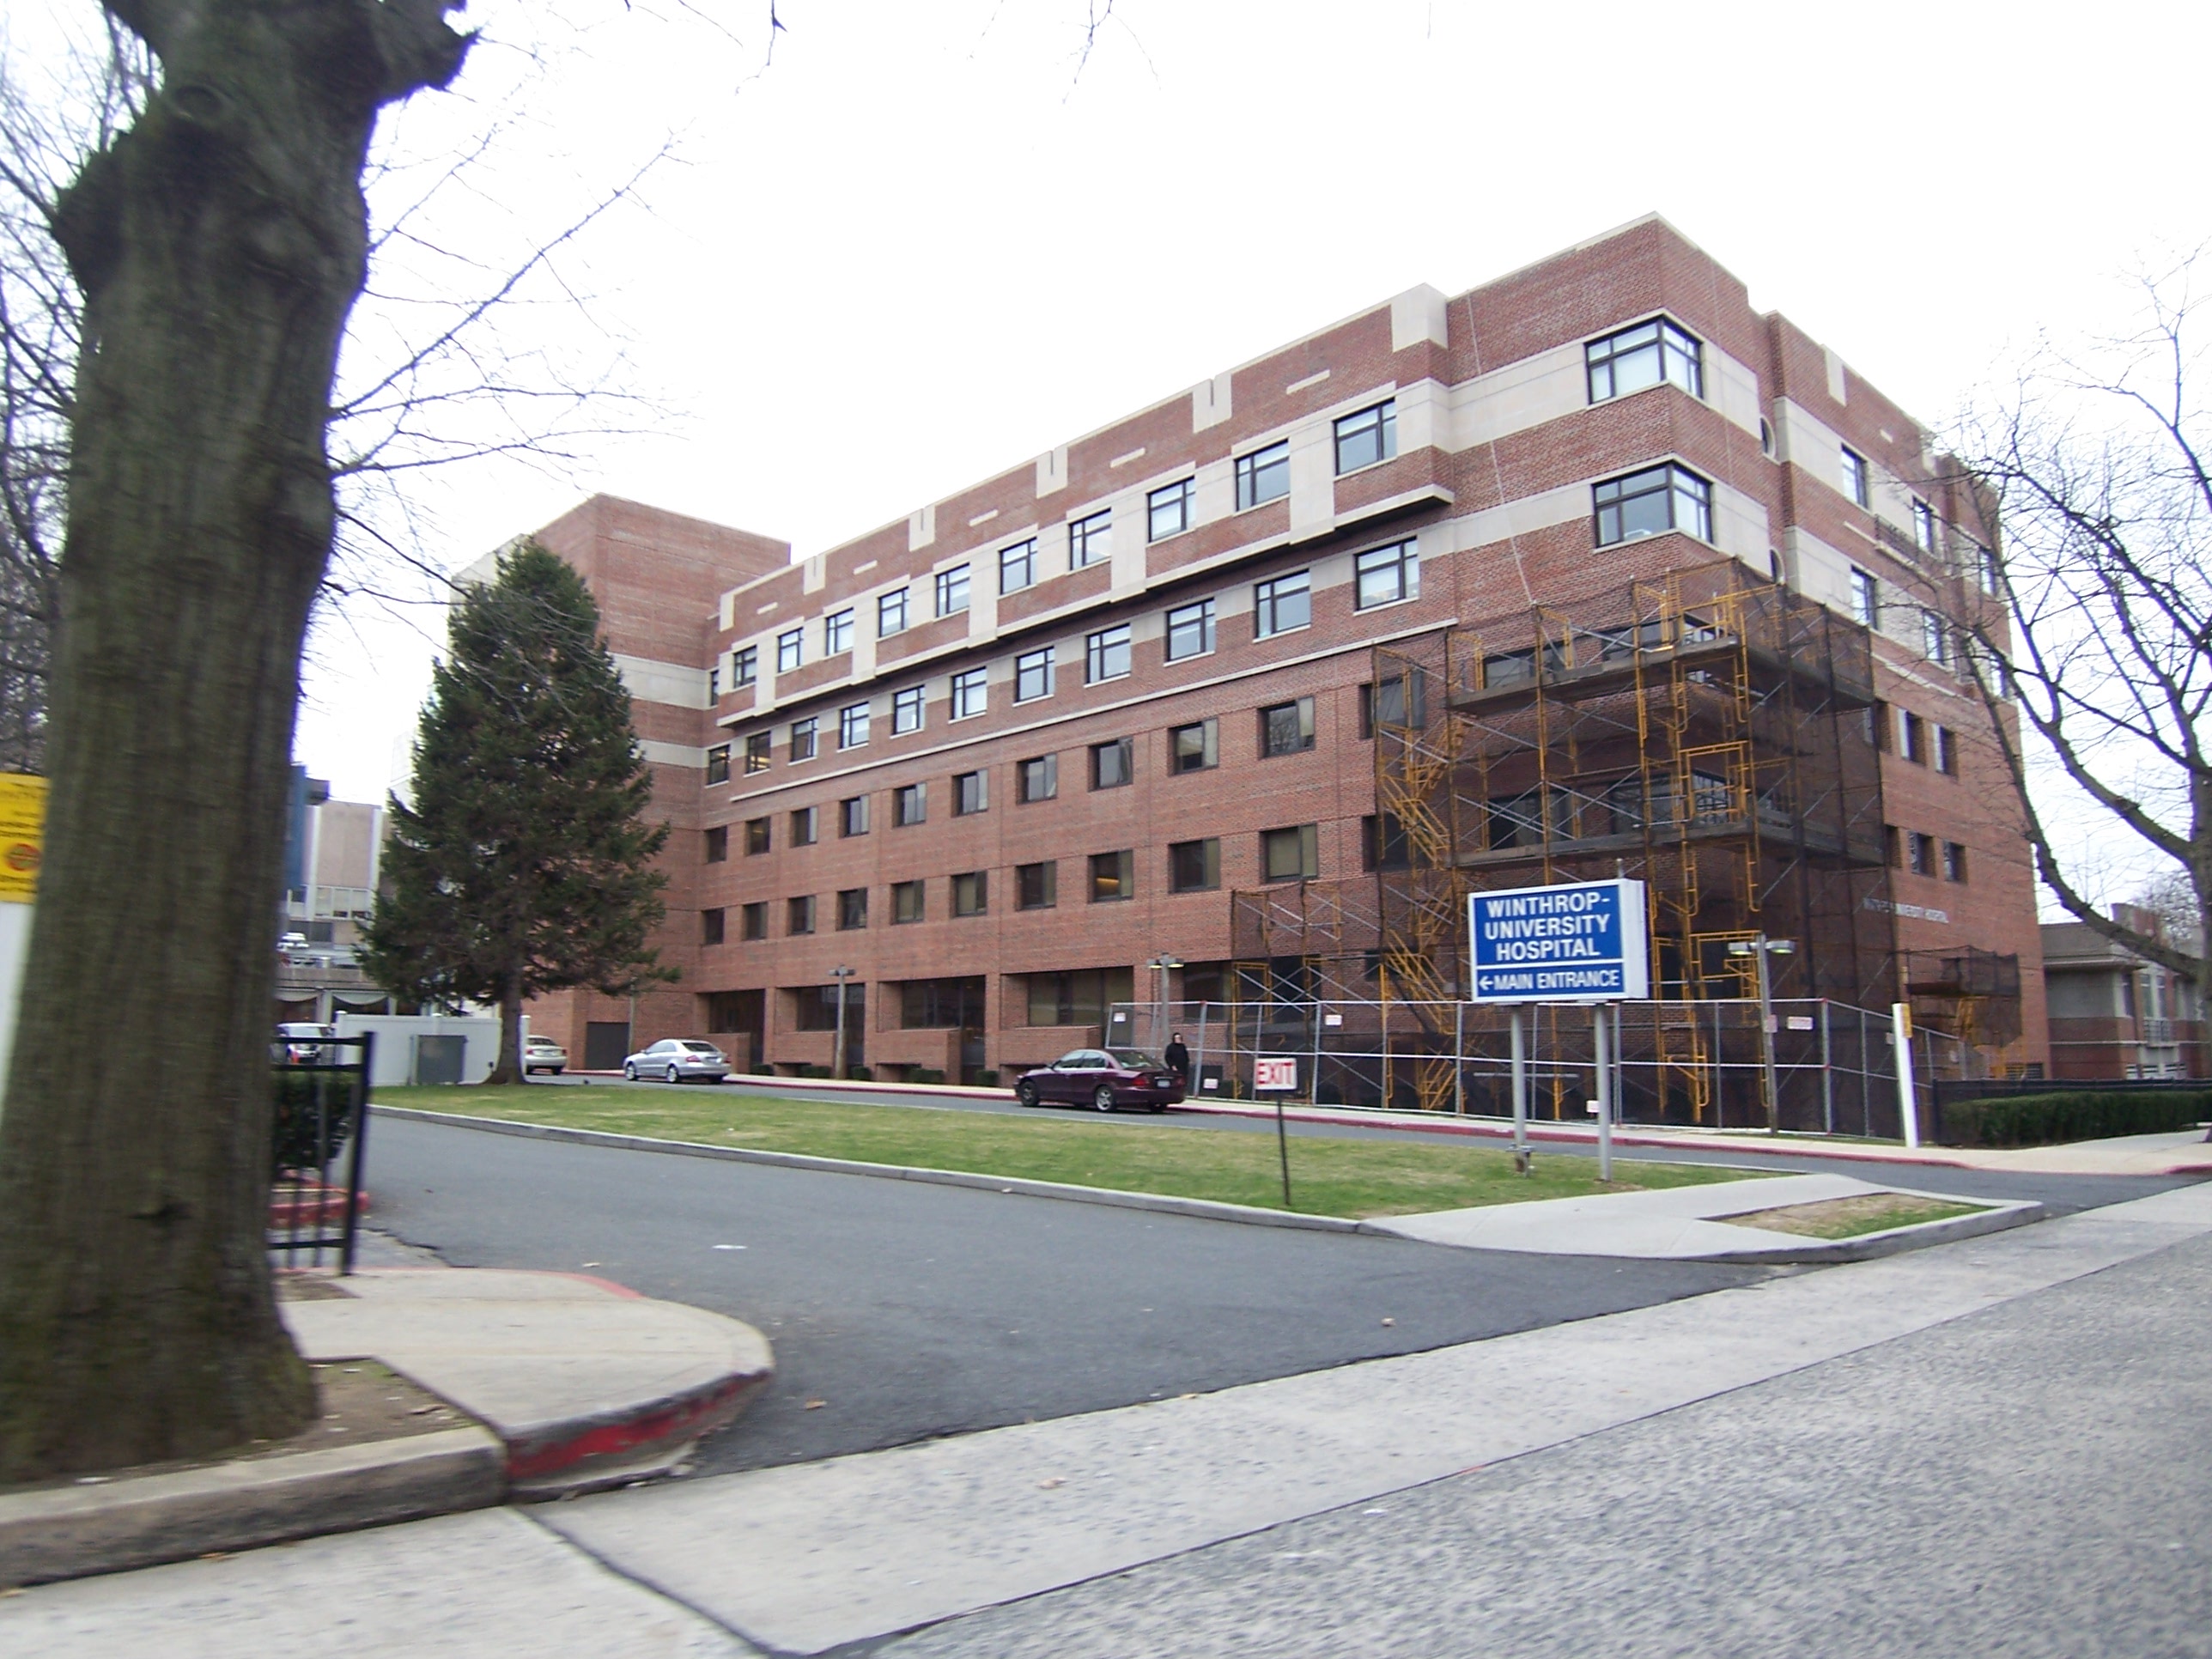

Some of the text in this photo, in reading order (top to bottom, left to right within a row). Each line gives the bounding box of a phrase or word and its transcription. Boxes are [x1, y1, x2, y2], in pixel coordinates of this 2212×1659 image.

[1487, 892, 1610, 917] WINTHROP-
[1486, 915, 1610, 939] UNIVERSITY
[1497, 939, 1601, 961] HOSPITAL
[1494, 970, 1620, 990] MAIN ENTRANCE
[1257, 1062, 1293, 1085] EXIT
